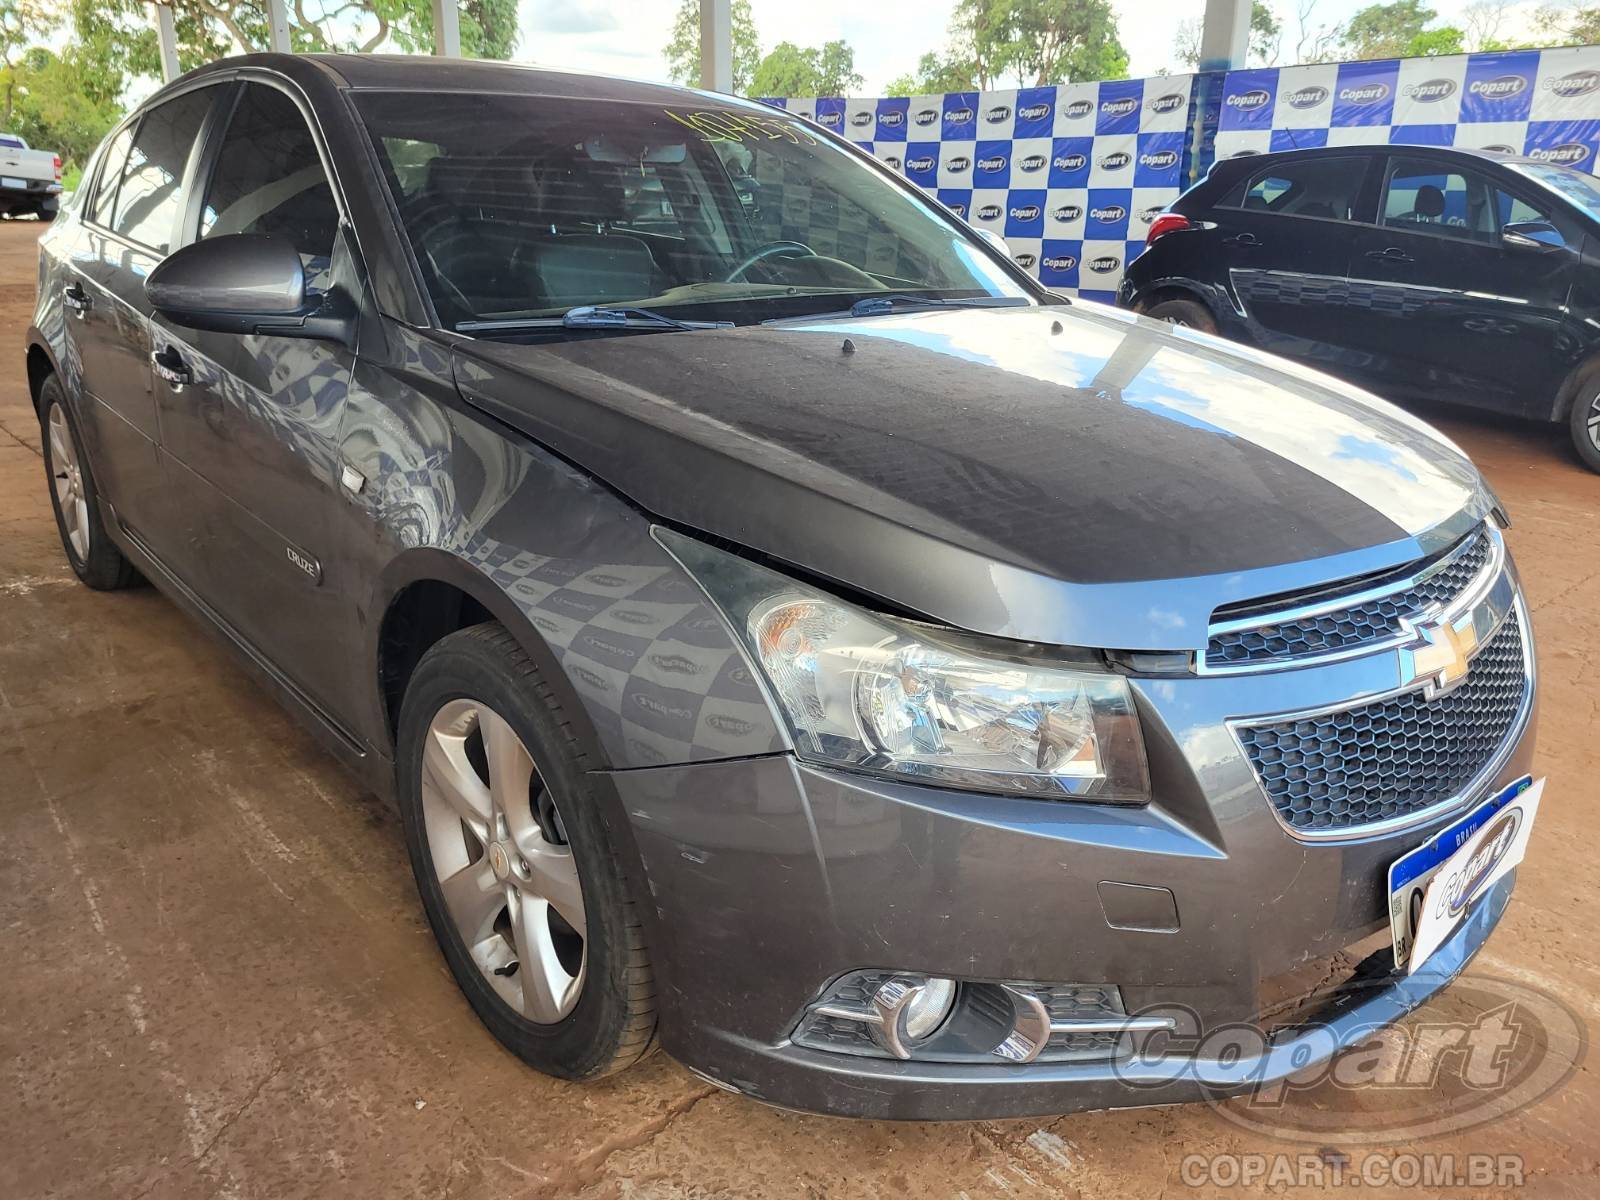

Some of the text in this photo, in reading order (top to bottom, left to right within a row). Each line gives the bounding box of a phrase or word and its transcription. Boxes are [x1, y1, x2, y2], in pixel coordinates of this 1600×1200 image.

[1470, 79, 1519, 95] Copart
[1543, 75, 1597, 91] Copart
[1281, 90, 1322, 104] Copart
[1340, 86, 1384, 102] Copart
[1402, 83, 1448, 98] Copart
[1226, 93, 1265, 107] Copart
[1019, 106, 1047, 119] Copart
[1101, 101, 1133, 115] Copart
[879, 113, 901, 124] Copart
[945, 110, 970, 122] Copart
[1139, 154, 1174, 168] Copart
[1530, 147, 1582, 162] Copart
[907, 159, 932, 170] Copart
[977, 159, 1003, 171] Copart
[1053, 157, 1082, 170] Copart
[1010, 207, 1037, 219] Copart
[1090, 208, 1121, 220] Copart
[1043, 257, 1074, 269] Copart
[286, 547, 315, 578] CRUZE
[1436, 819, 1513, 920] Copart
